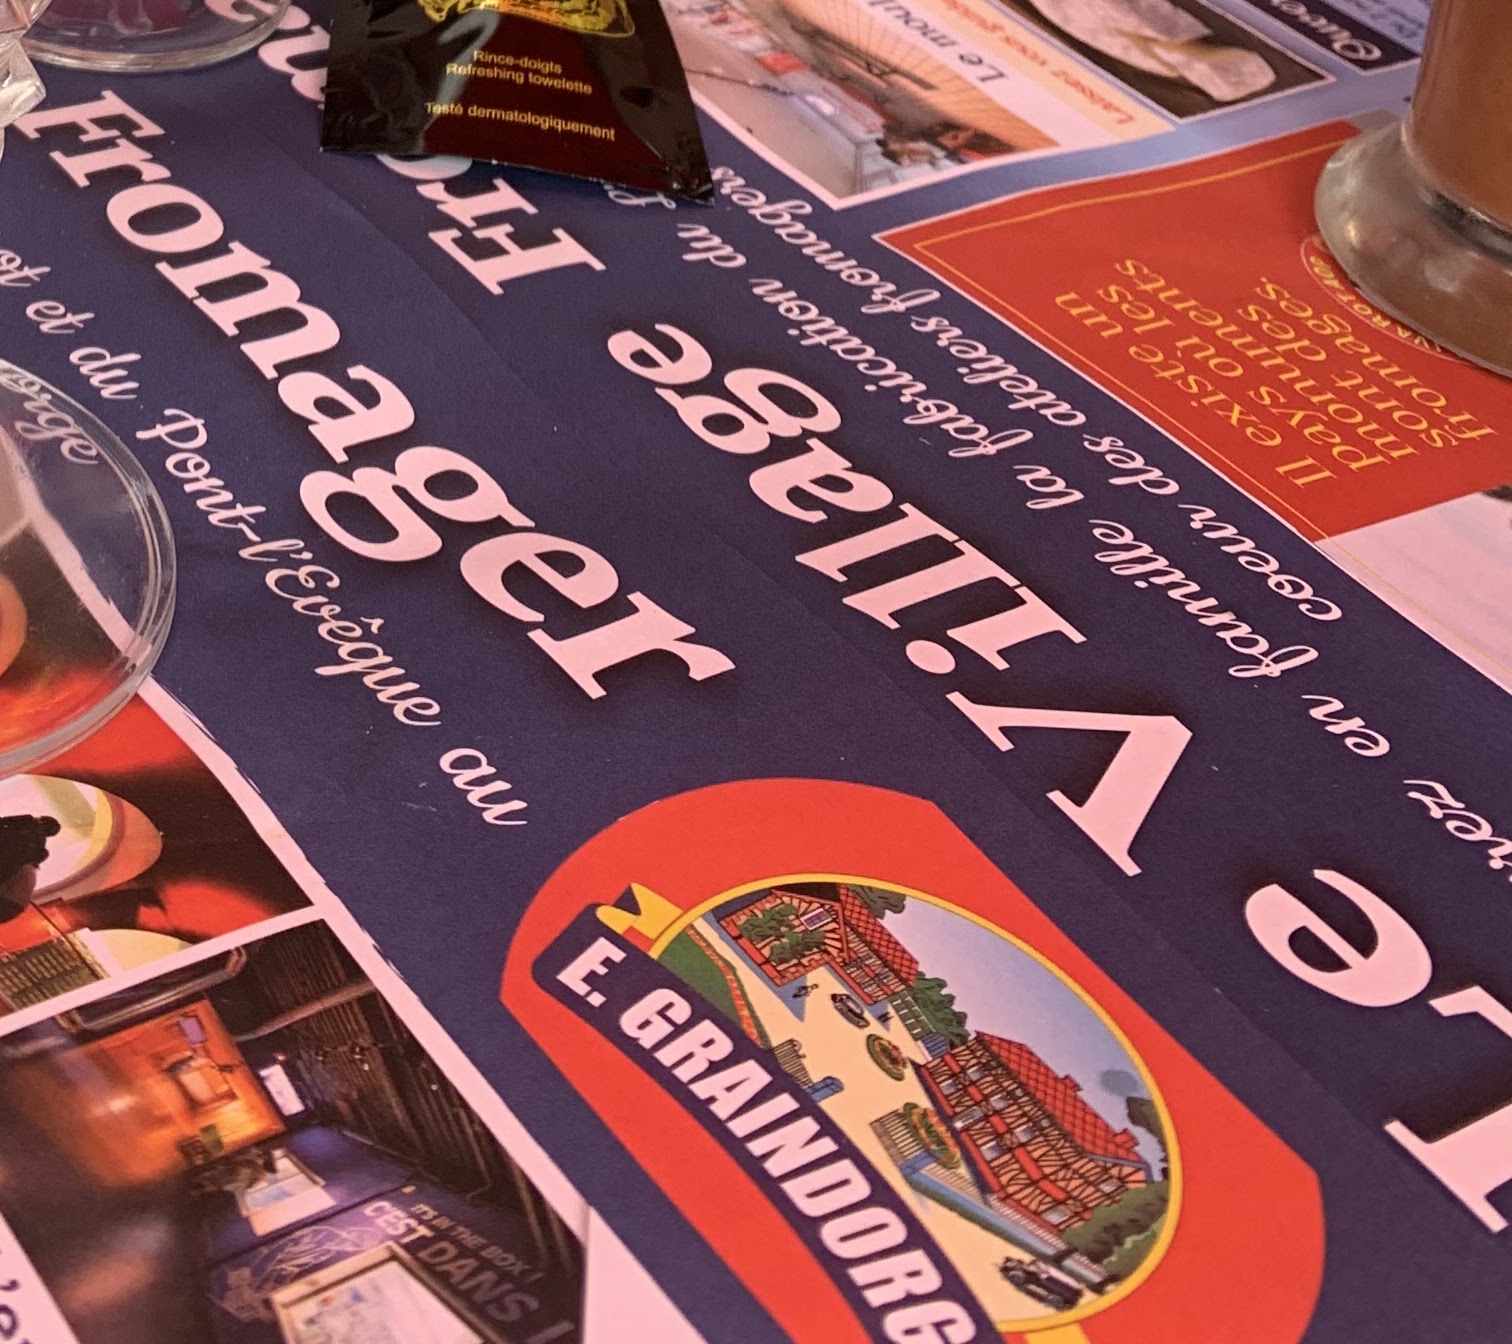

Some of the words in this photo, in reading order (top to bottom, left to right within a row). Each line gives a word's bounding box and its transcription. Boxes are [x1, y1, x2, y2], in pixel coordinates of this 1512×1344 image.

[424, 100, 465, 117] Testé
[467, 103, 617, 143] dermatologiquement
[445, 61, 525, 86] Refreshing
[527, 71, 594, 96] towelette
[472, 48, 563, 76] Rince-doigts
[958, 49, 1010, 84] Le
[12, 89, 737, 701] Fromager
[709, 164, 943, 315] fromagers
[909, 314, 1088, 428] ateliers
[1083, 432, 1181, 497] des
[1176, 502, 1344, 622] coeur
[1053, 288, 1125, 341] un
[1127, 340, 1284, 450] existe
[1272, 454, 1340, 491] Il
[1094, 282, 1177, 337] les
[1173, 332, 1247, 381] où
[1246, 382, 1391, 474] pays
[1114, 257, 1422, 464] monuments
[1235, 302, 1329, 364] des
[1329, 365, 1462, 451] sont
[1254, 275, 1501, 442] fromages.
[25, 297, 96, 336] et
[68, 344, 143, 401] du
[135, 407, 444, 728] Pont-l'Evêque
[438, 745, 530, 827] au
[676, 221, 748, 269] du
[748, 277, 1035, 460] fabrication
[1012, 462, 1087, 511] la
[1087, 517, 1321, 679] famille
[1300, 692, 1391, 759] en
[605, 321, 1196, 878] Village
[553, 934, 632, 1011] E.
[614, 980, 980, 1344] GRAINDORG
[416, 1240, 542, 1323] DANS
[479, 1244, 533, 1279] BOX
